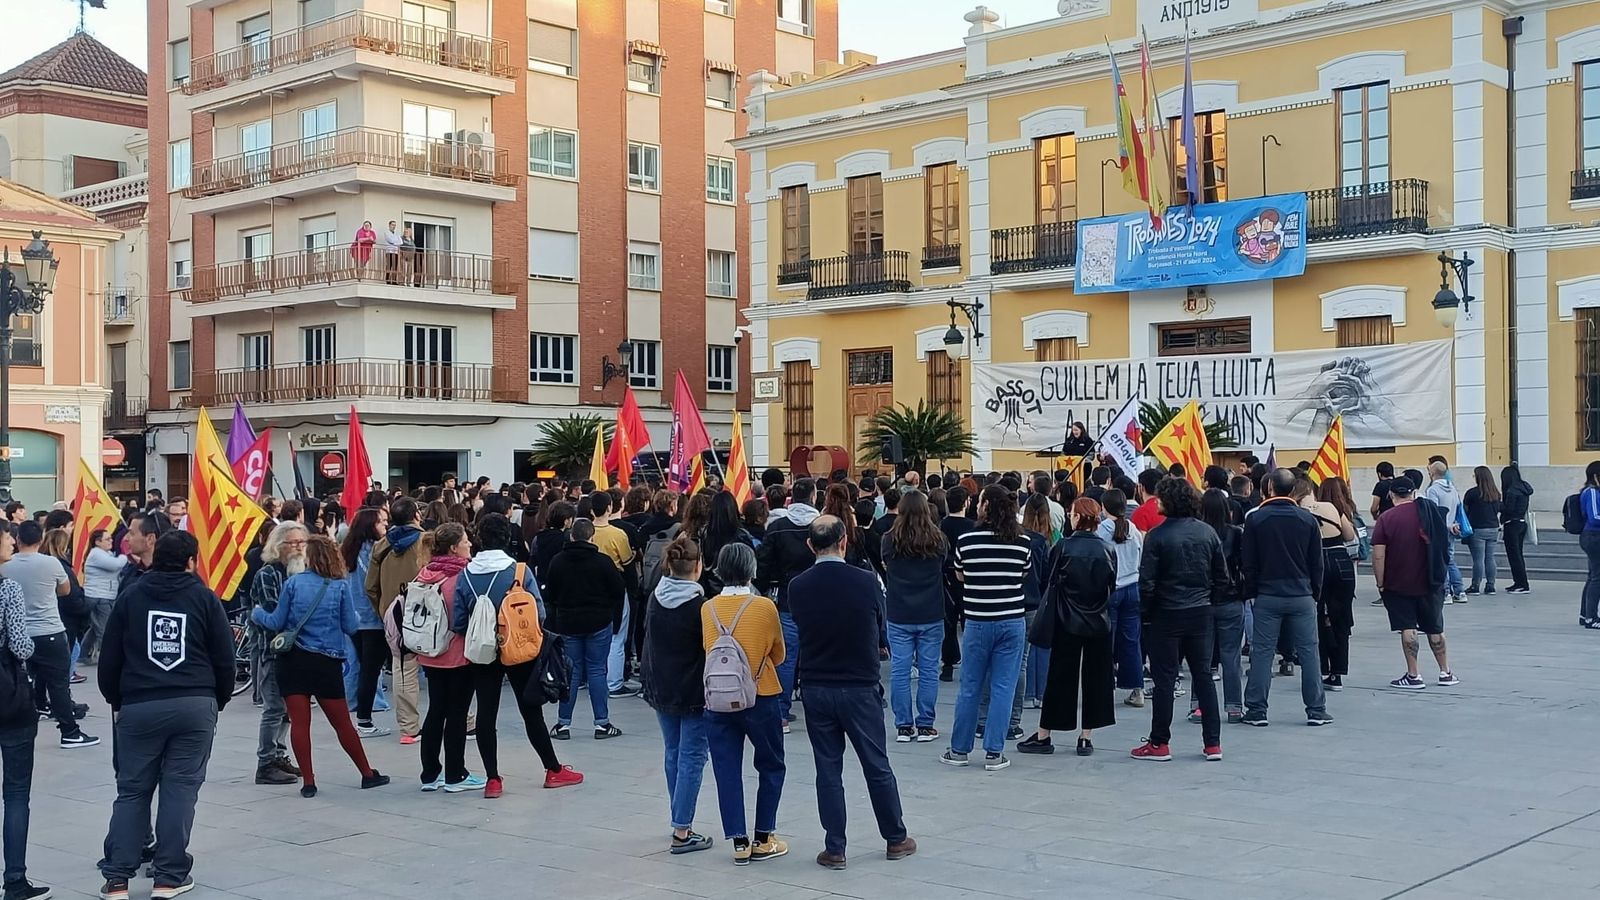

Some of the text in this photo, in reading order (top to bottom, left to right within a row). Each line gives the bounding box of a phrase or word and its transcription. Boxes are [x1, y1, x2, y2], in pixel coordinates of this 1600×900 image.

[1188, 215, 1222, 246] 2024
[985, 379, 1043, 414] BASSOT
[1040, 364, 1119, 401] GUILLEM
[1156, 360, 1202, 400] TEUA
[1212, 357, 1276, 398] LLUITA
[1215, 402, 1268, 445] MANS
